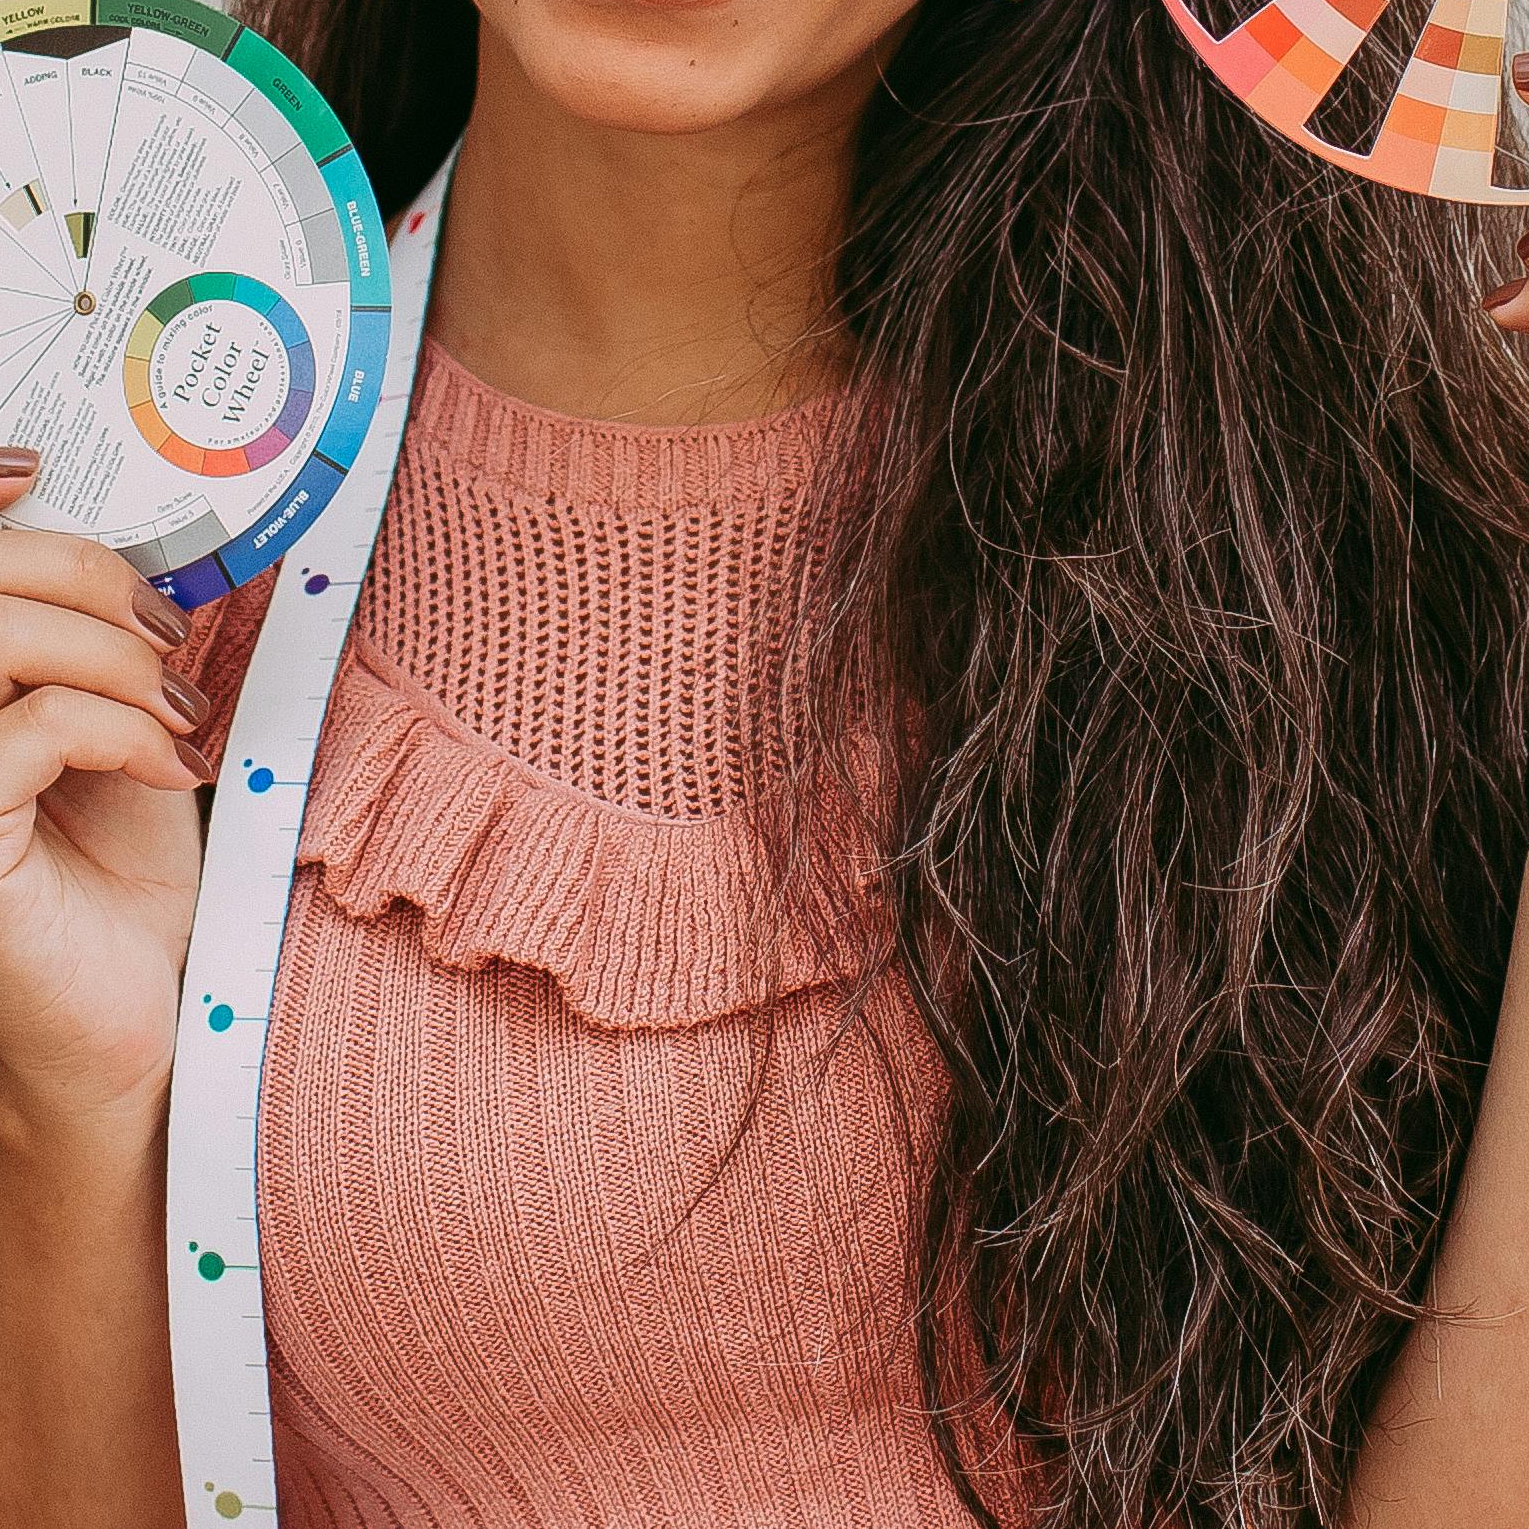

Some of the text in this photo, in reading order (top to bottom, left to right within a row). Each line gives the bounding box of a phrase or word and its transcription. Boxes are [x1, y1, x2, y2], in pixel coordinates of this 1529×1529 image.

[1, 6, 46, 25] YELLOW
[127, 3, 211, 38] YELLOW-GREEN
[24, 67, 113, 86] ADDING BLACK
[272, 78, 303, 112] GREEN
[346, 200, 371, 278] BLUE-GREEN
[154, 304, 214, 409] A guide to mixing color
[172, 321, 222, 404] Pocket
[201, 341, 243, 408] Color
[347, 369, 365, 403] BLUE
[252, 489, 310, 550] BLUE-VIOLET
